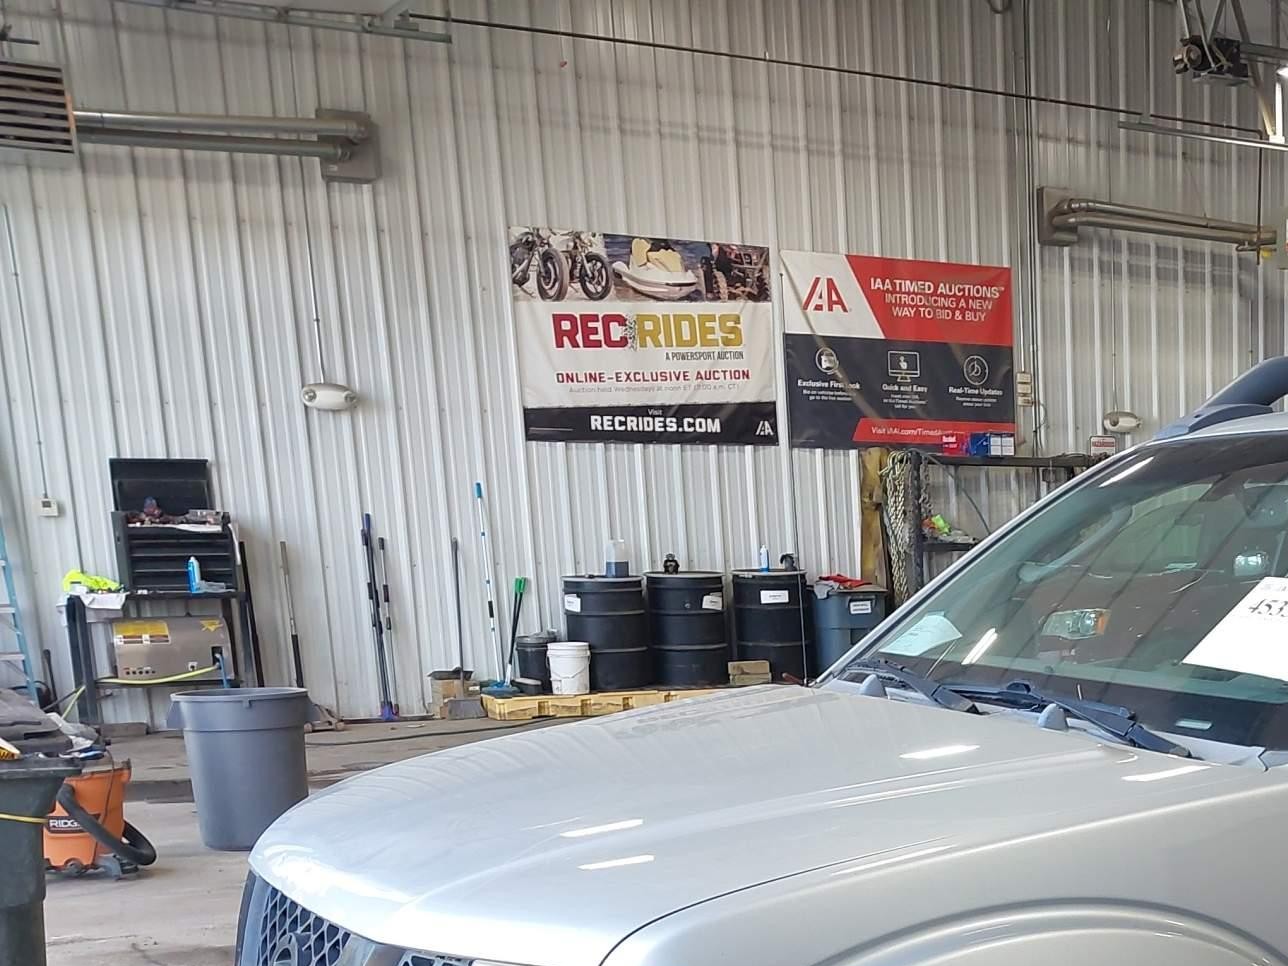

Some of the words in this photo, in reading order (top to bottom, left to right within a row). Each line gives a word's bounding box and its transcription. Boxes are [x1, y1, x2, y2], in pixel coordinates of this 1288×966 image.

[870, 277, 892, 291] IAA
[894, 279, 934, 293] TIMED
[885, 293, 956, 308] INTRODUCING
[958, 298, 967, 308] A
[969, 300, 992, 310] NEW
[892, 306, 915, 318] WAY
[920, 308, 933, 318] TO
[936, 309, 952, 320] BID
[954, 311, 962, 320] &
[965, 312, 986, 321] BUY
[552, 313, 628, 349] REC
[635, 313, 744, 348] RIDES
[665, 351, 670, 360] A
[671, 351, 716, 361] POWERSPORT
[717, 351, 744, 360] AUCTION
[556, 370, 690, 384] ONLINE-EXCLUSIVE
[695, 369, 750, 382] AUCTION
[797, 379, 829, 388] Exclusive
[882, 383, 899, 391] Quick
[913, 384, 928, 392] Easy
[980, 387, 1003, 396] Updates
[648, 408, 663, 416] Visit
[590, 415, 721, 433] RECRIDES.COM
[871, 426, 886, 435] Visit
